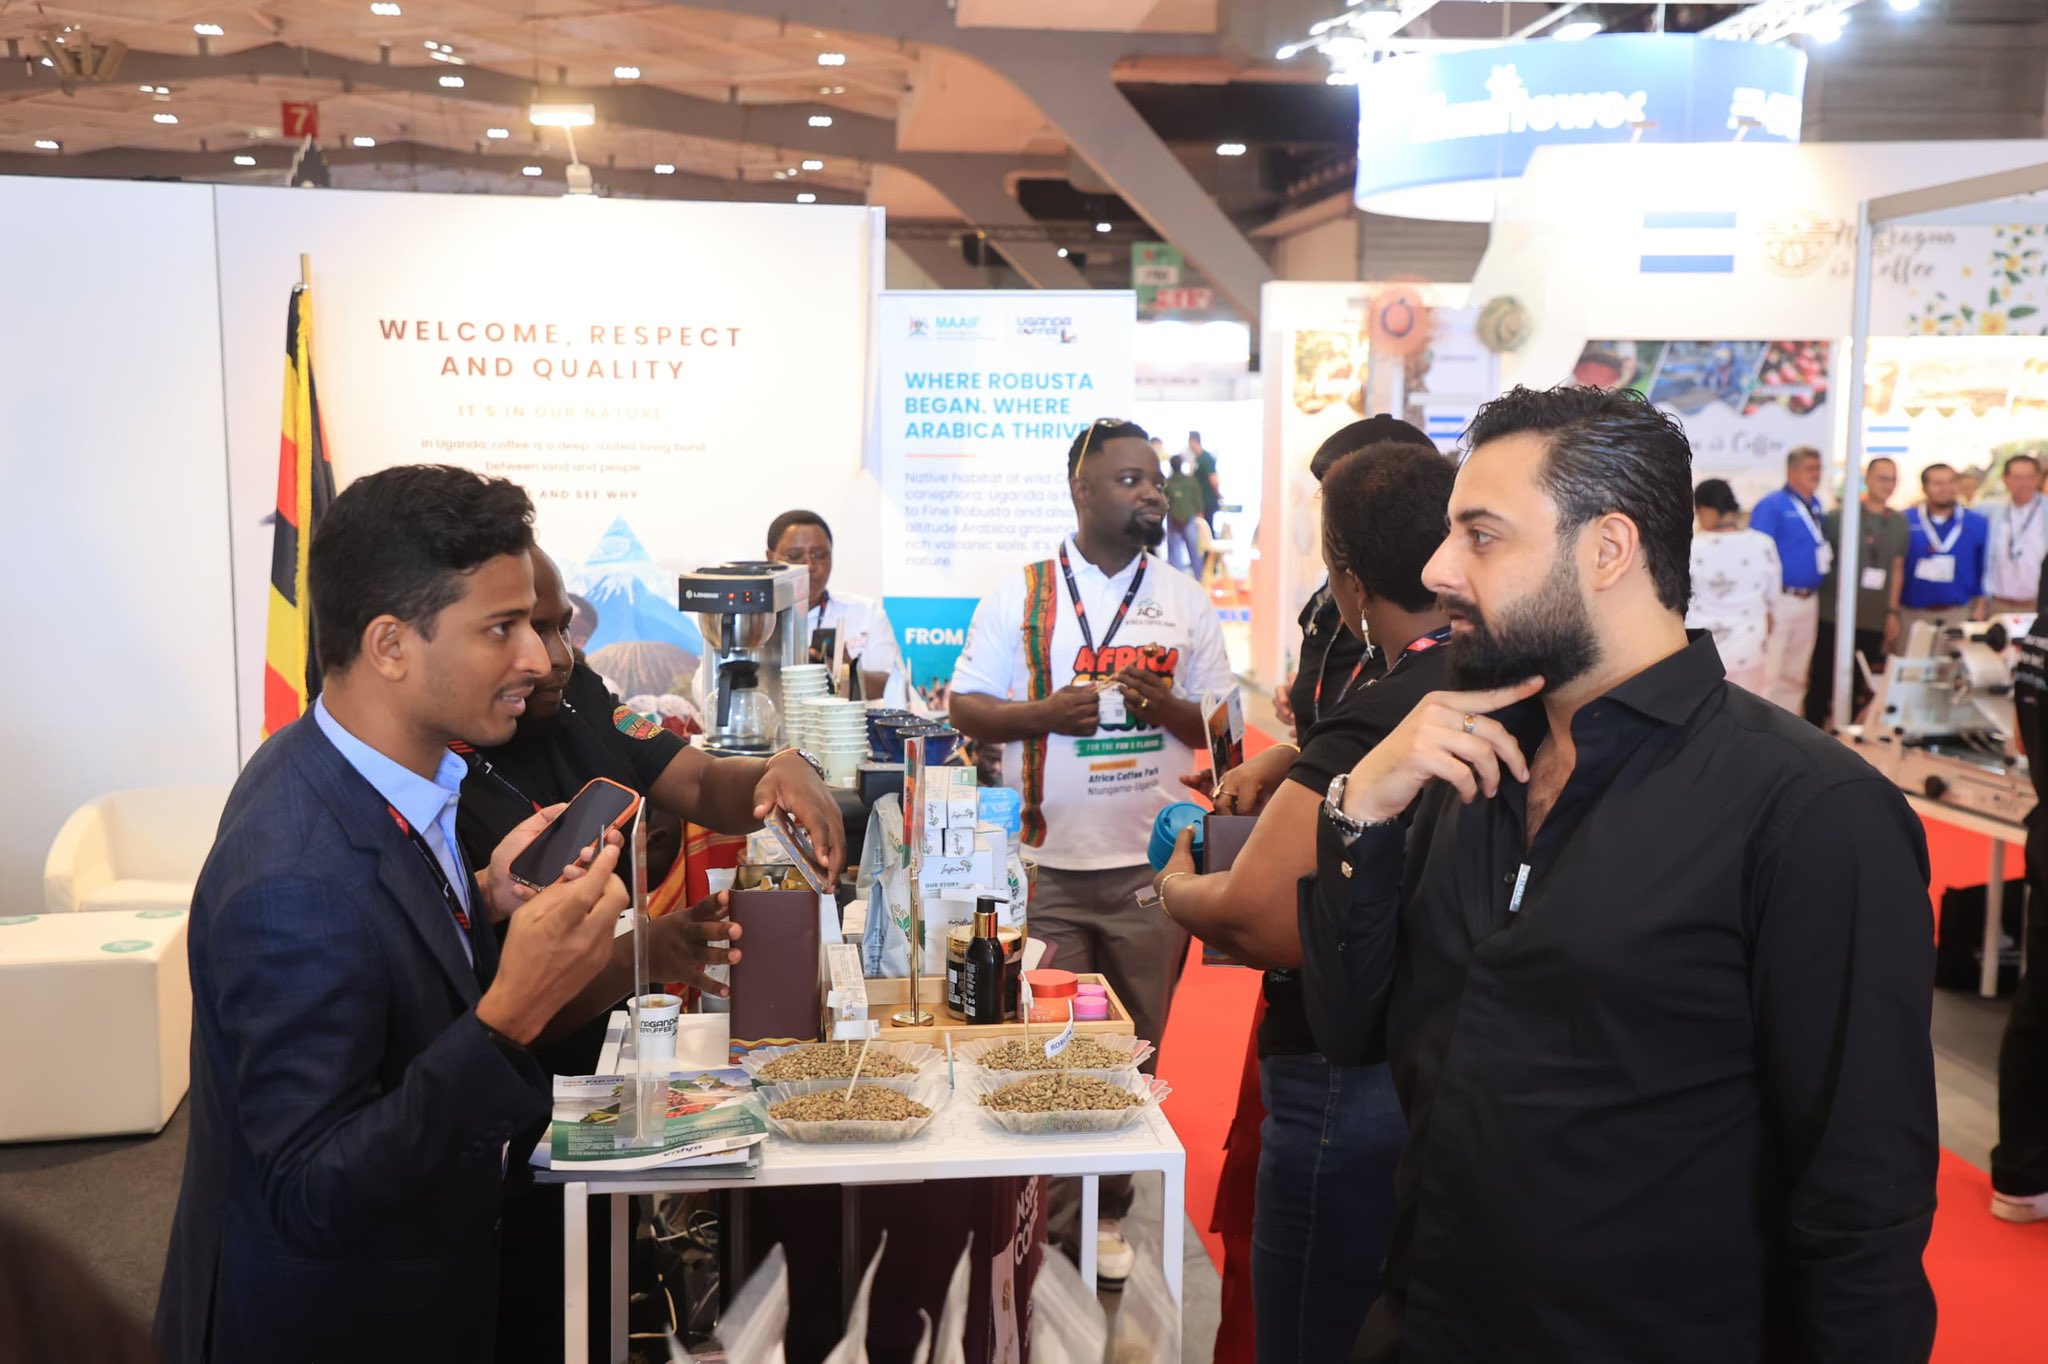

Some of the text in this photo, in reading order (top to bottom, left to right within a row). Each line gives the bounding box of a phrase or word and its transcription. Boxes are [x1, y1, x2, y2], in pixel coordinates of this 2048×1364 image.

[290, 106, 310, 133] 7
[935, 316, 981, 329] MAAIF
[379, 319, 743, 348] WELCOME, RESPECT
[440, 356, 686, 381] AND QUALITY
[904, 372, 1094, 391] WHERE ROBUSTA
[505, 404, 525, 418] IN
[534, 405, 576, 419] OUR
[904, 397, 1071, 415] BEGAN. WHERE
[904, 422, 1003, 440] ARABICA
[421, 438, 433, 449] In
[491, 440, 530, 450] coffee
[485, 461, 540, 472] between
[542, 461, 571, 472] land
[573, 462, 598, 473] and
[904, 472, 949, 484] Native
[952, 472, 1003, 484] habitat
[1024, 472, 1052, 484] wild
[539, 489, 570, 500] AND
[575, 490, 600, 500] SEE
[606, 490, 640, 500] WHY
[989, 489, 1046, 503] Uganda
[904, 506, 918, 518] to
[922, 506, 950, 518] Fine
[953, 506, 1012, 518] Robusta
[1014, 506, 1042, 518] and
[904, 522, 958, 534] altitude
[961, 522, 1017, 534] Arabica
[904, 538, 932, 551] rich
[934, 538, 993, 551] volcanic
[904, 627, 964, 646] FROM
[1086, 743, 1100, 752] FOR
[1101, 742, 1114, 751] THE
[1115, 741, 1130, 750] FUN
[1088, 774, 1116, 784] Africa
[1116, 770, 1143, 781] Coffee
